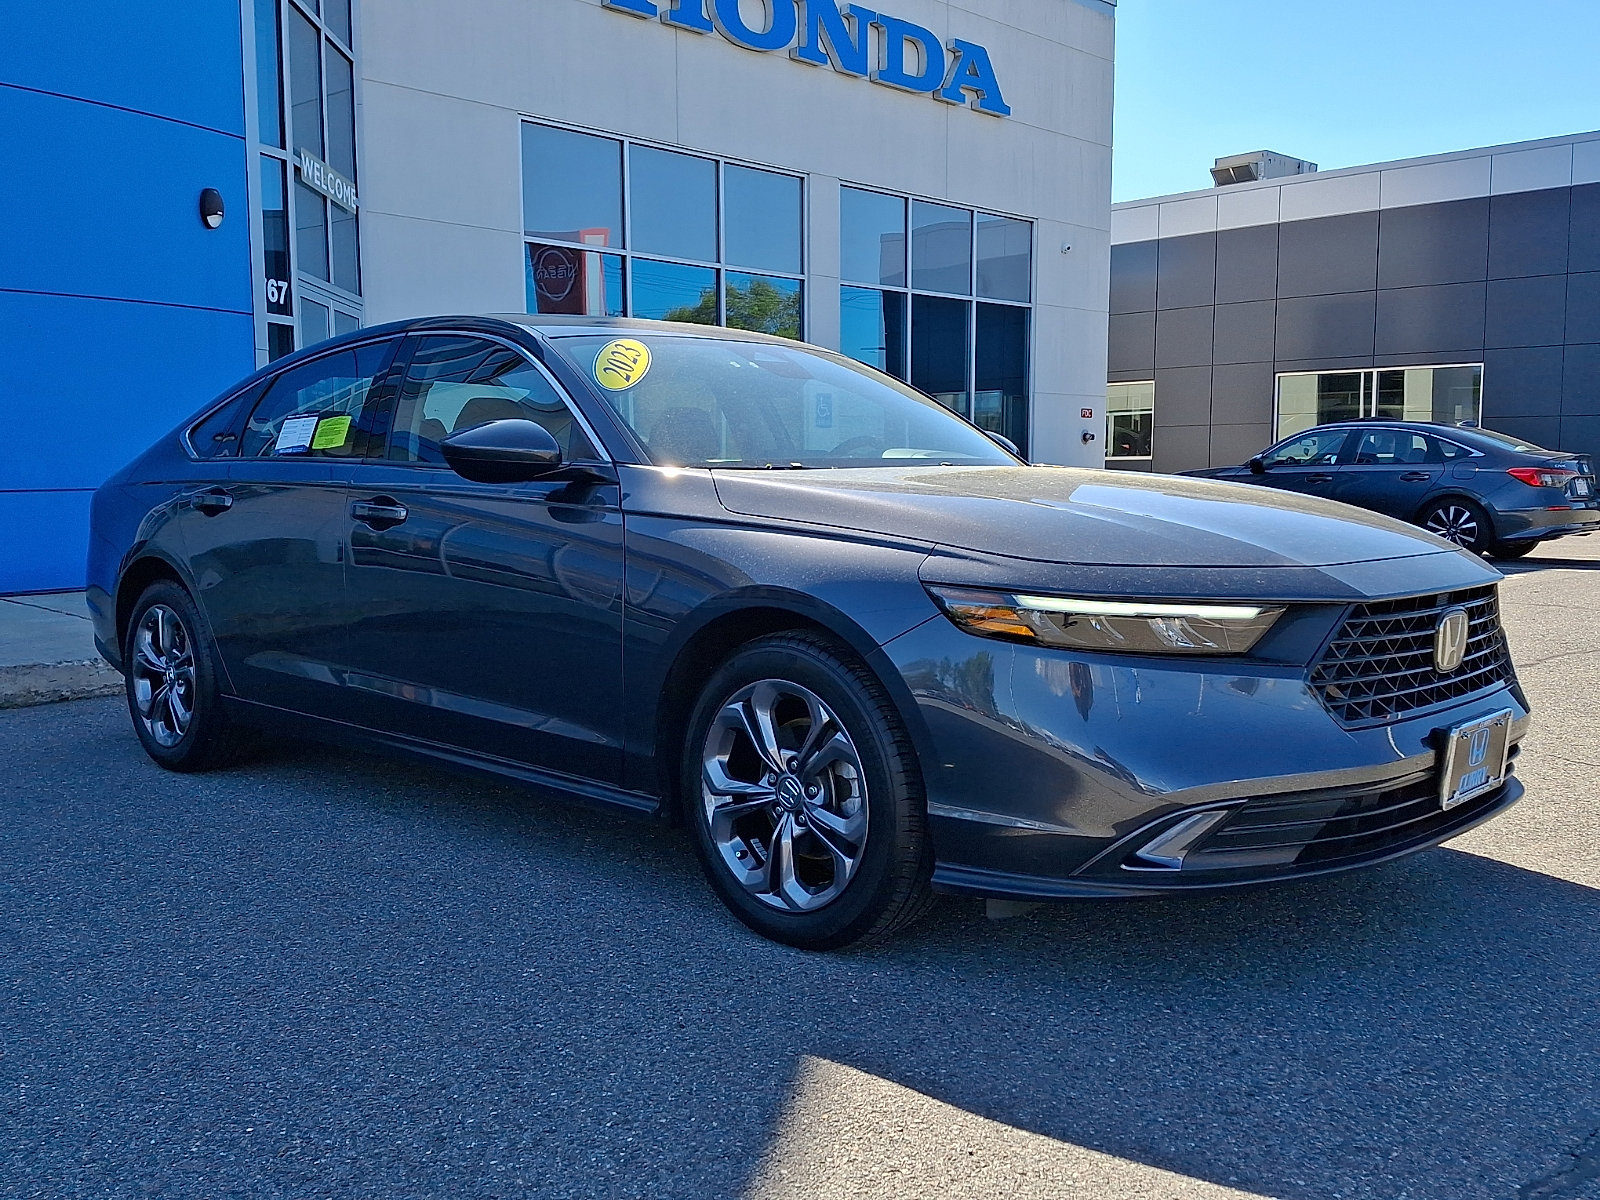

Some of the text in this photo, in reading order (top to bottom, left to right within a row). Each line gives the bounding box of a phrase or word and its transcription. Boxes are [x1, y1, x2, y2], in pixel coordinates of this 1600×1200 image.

[301, 152, 357, 208] WELCOME
[265, 278, 288, 304] 67
[603, 344, 641, 382] 2023
